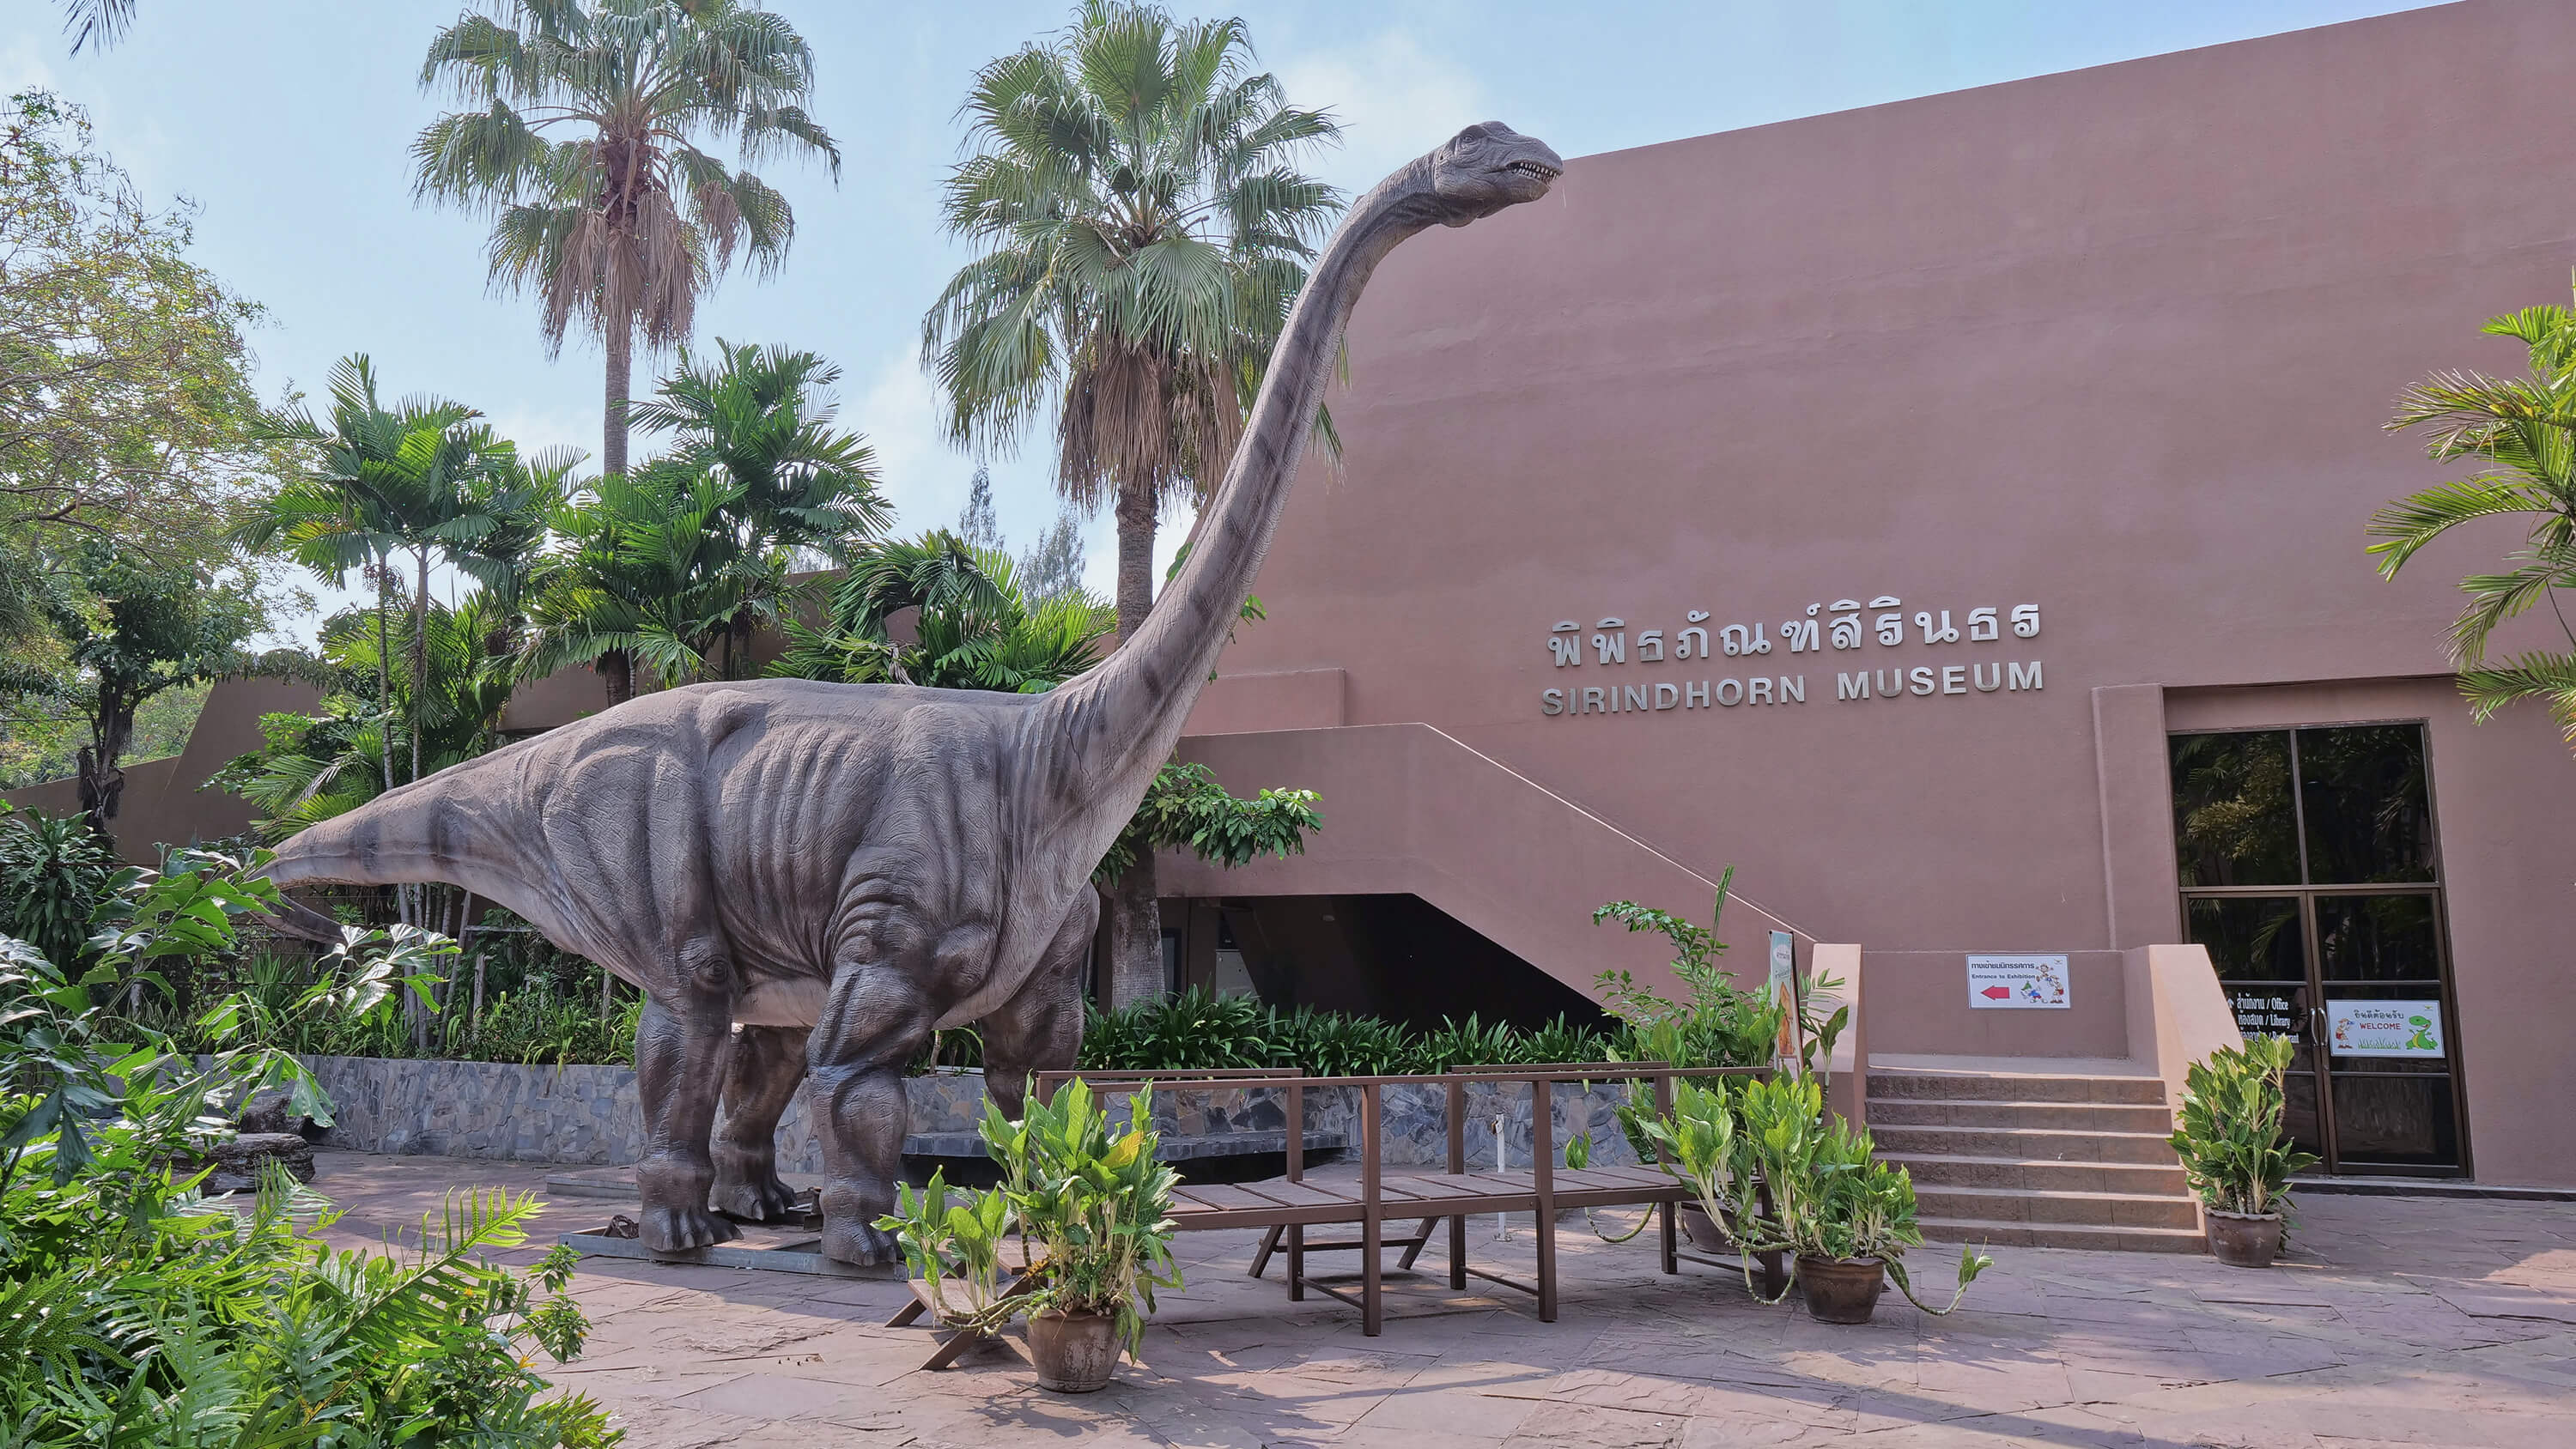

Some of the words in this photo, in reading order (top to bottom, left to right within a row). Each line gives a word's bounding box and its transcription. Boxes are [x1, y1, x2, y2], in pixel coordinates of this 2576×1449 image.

[1546, 595, 2040, 667] พิพิธภัณฑ์สิรินธร
[1541, 674, 1806, 716] SIRINDHORN
[1836, 660, 2044, 701] MUSEUM
[2271, 997, 2289, 1010] Office
[2269, 1014, 2291, 1029] Library
